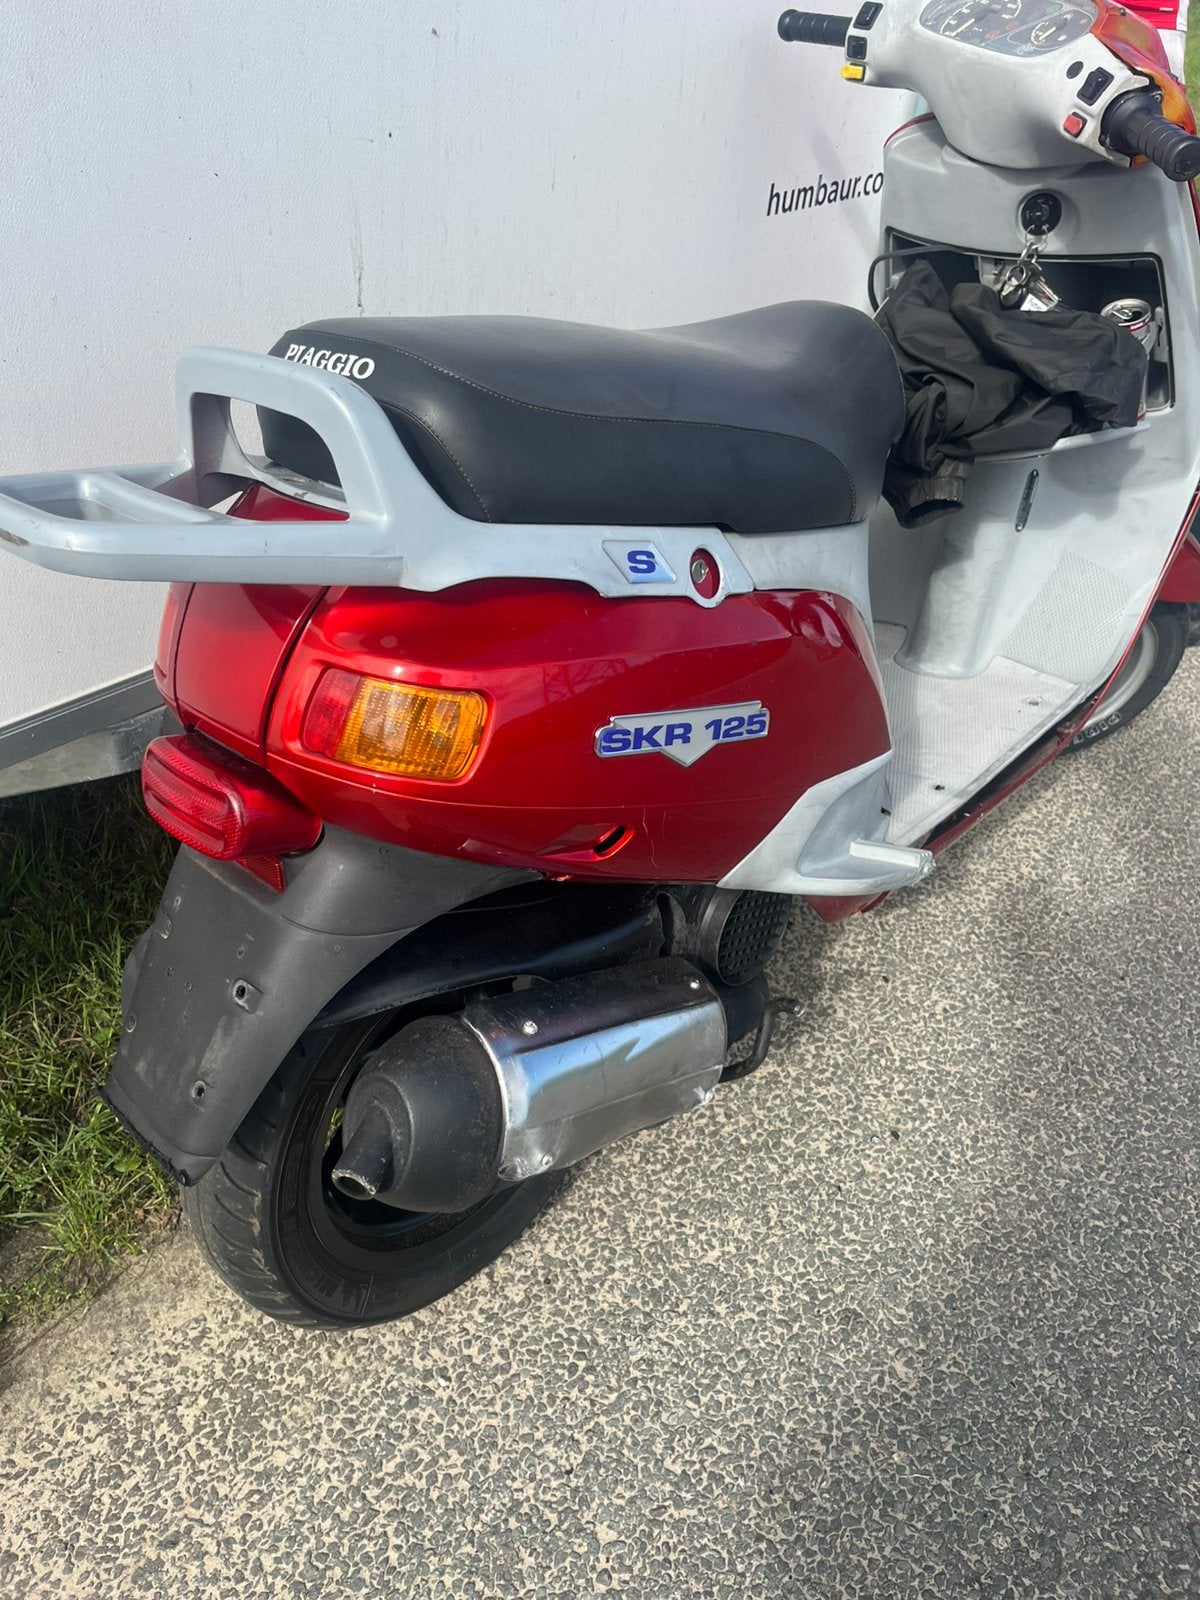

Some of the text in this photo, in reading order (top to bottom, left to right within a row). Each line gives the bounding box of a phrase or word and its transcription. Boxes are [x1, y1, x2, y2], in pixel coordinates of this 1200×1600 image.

[284, 343, 376, 380] PIAGGIO
[627, 550, 656, 574] S
[601, 712, 767, 753] SKR 125
